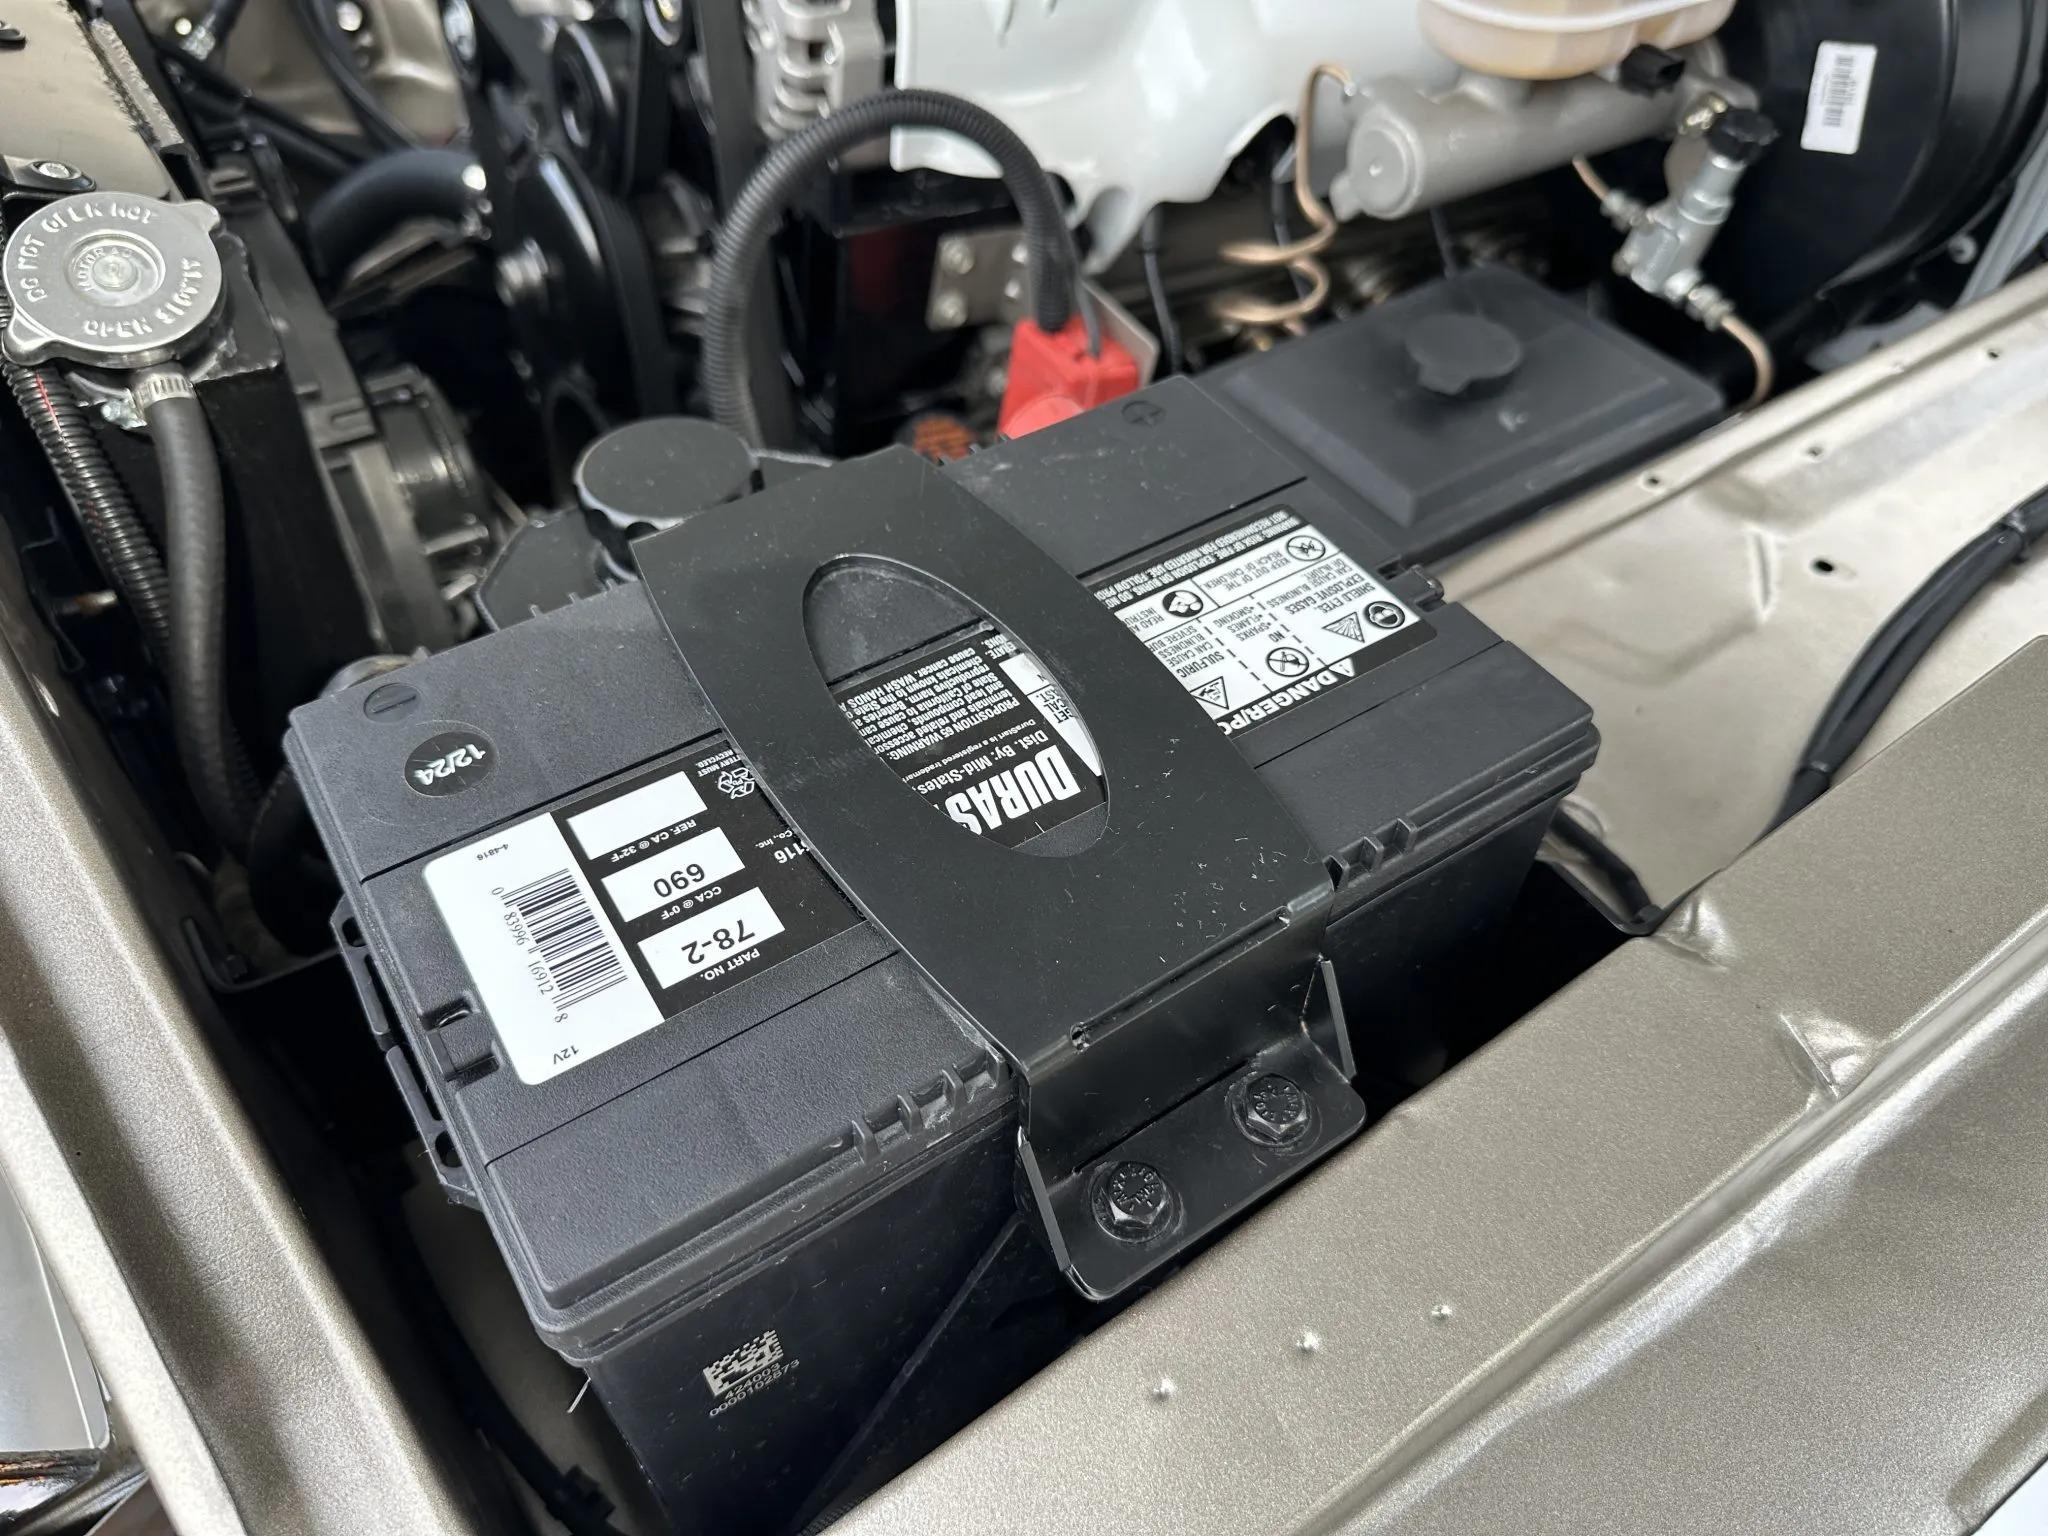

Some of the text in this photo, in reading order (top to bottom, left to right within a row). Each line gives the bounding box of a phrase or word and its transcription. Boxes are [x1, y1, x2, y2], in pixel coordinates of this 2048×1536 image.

[1113, 572, 1149, 593] FOLLOW
[1117, 590, 1134, 603] DO
[1266, 583, 1311, 609] BLINDNESS
[1284, 572, 1365, 615] EXPLOSIVE GASES
[1314, 582, 1376, 614] SHIELD EYES.
[1139, 613, 1165, 629] READ
[1212, 606, 1253, 628] SMOKING
[1226, 614, 1261, 634] FLAMES
[1163, 625, 1198, 645] SEVERE
[1235, 622, 1270, 642] SPARKS
[1268, 630, 1286, 643] NO
[947, 647, 976, 664] cause
[1157, 633, 1206, 659] BLINDNESS
[1166, 641, 1214, 668] CAN CAUSE
[913, 658, 949, 678] cancer.
[935, 655, 983, 680] chemicals
[1175, 651, 1225, 679] SULFURIC
[882, 673, 918, 694] WASH
[905, 674, 939, 694] known
[933, 663, 991, 693] reproductive
[960, 682, 973, 694] of
[971, 672, 999, 688] State
[984, 680, 1005, 695] and
[846, 686, 886, 709] HANDS
[878, 692, 898, 705] the
[894, 688, 908, 698] to
[904, 687, 936, 704] harm.
[915, 687, 964, 712] California
[963, 688, 988, 705] lead
[966, 688, 1013, 713] terminals
[853, 700, 881, 716] State
[862, 700, 908, 724] Batteries
[905, 706, 919, 717] to
[906, 697, 966, 726] compounds,
[948, 707, 969, 723] and
[877, 711, 907, 729] cause
[886, 696, 1021, 760] PROPOSITION 65 WARNING:
[914, 715, 950, 738] related
[997, 718, 1037, 740] DuraStart
[988, 735, 999, 743] is
[414, 743, 486, 786] 12/24
[695, 749, 734, 768] RECYCLED.
[911, 729, 1049, 795] Dist. By: Mid-States,
[941, 742, 983, 766] registered
[697, 763, 720, 777] MUST
[729, 777, 744, 789] Pb
[934, 744, 1082, 836] DURAS
[610, 819, 697, 863] REF. CA @ 32°F
[755, 829, 793, 849] Co., Inc.
[476, 843, 509, 861] 4-4816
[653, 863, 705, 898] 690
[682, 899, 694, 909] @
[694, 886, 722, 903] CCA
[680, 919, 756, 965] 78-2
[491, 886, 569, 1023] 0 83996 16912 8
[700, 947, 761, 981] PART NO.
[553, 1045, 579, 1065] 12V
[709, 1359, 800, 1417] 0000102873
[724, 1362, 781, 1400] 424003
